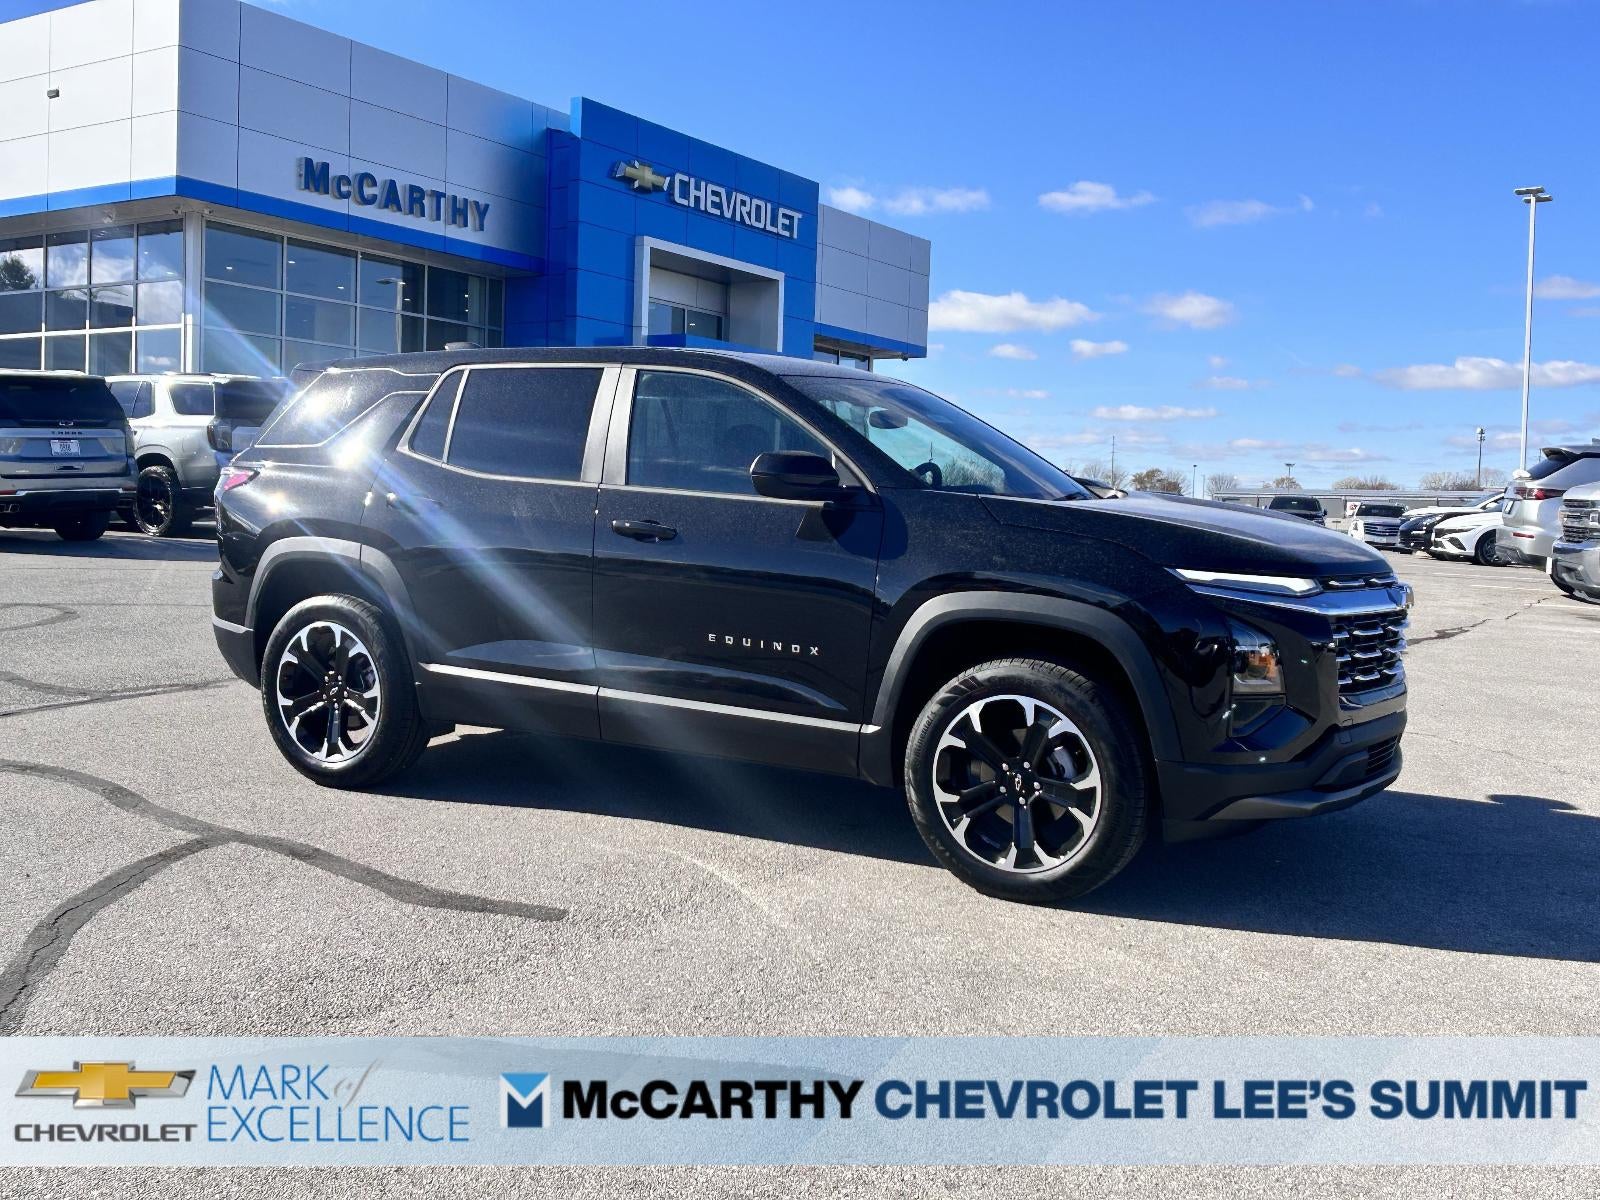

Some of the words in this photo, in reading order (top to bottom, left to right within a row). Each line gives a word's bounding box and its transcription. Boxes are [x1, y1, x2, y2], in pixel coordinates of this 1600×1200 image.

[297, 156, 490, 232] McCARTHY
[674, 172, 802, 239] CHEVROLET
[708, 633, 819, 656] EQUINOX
